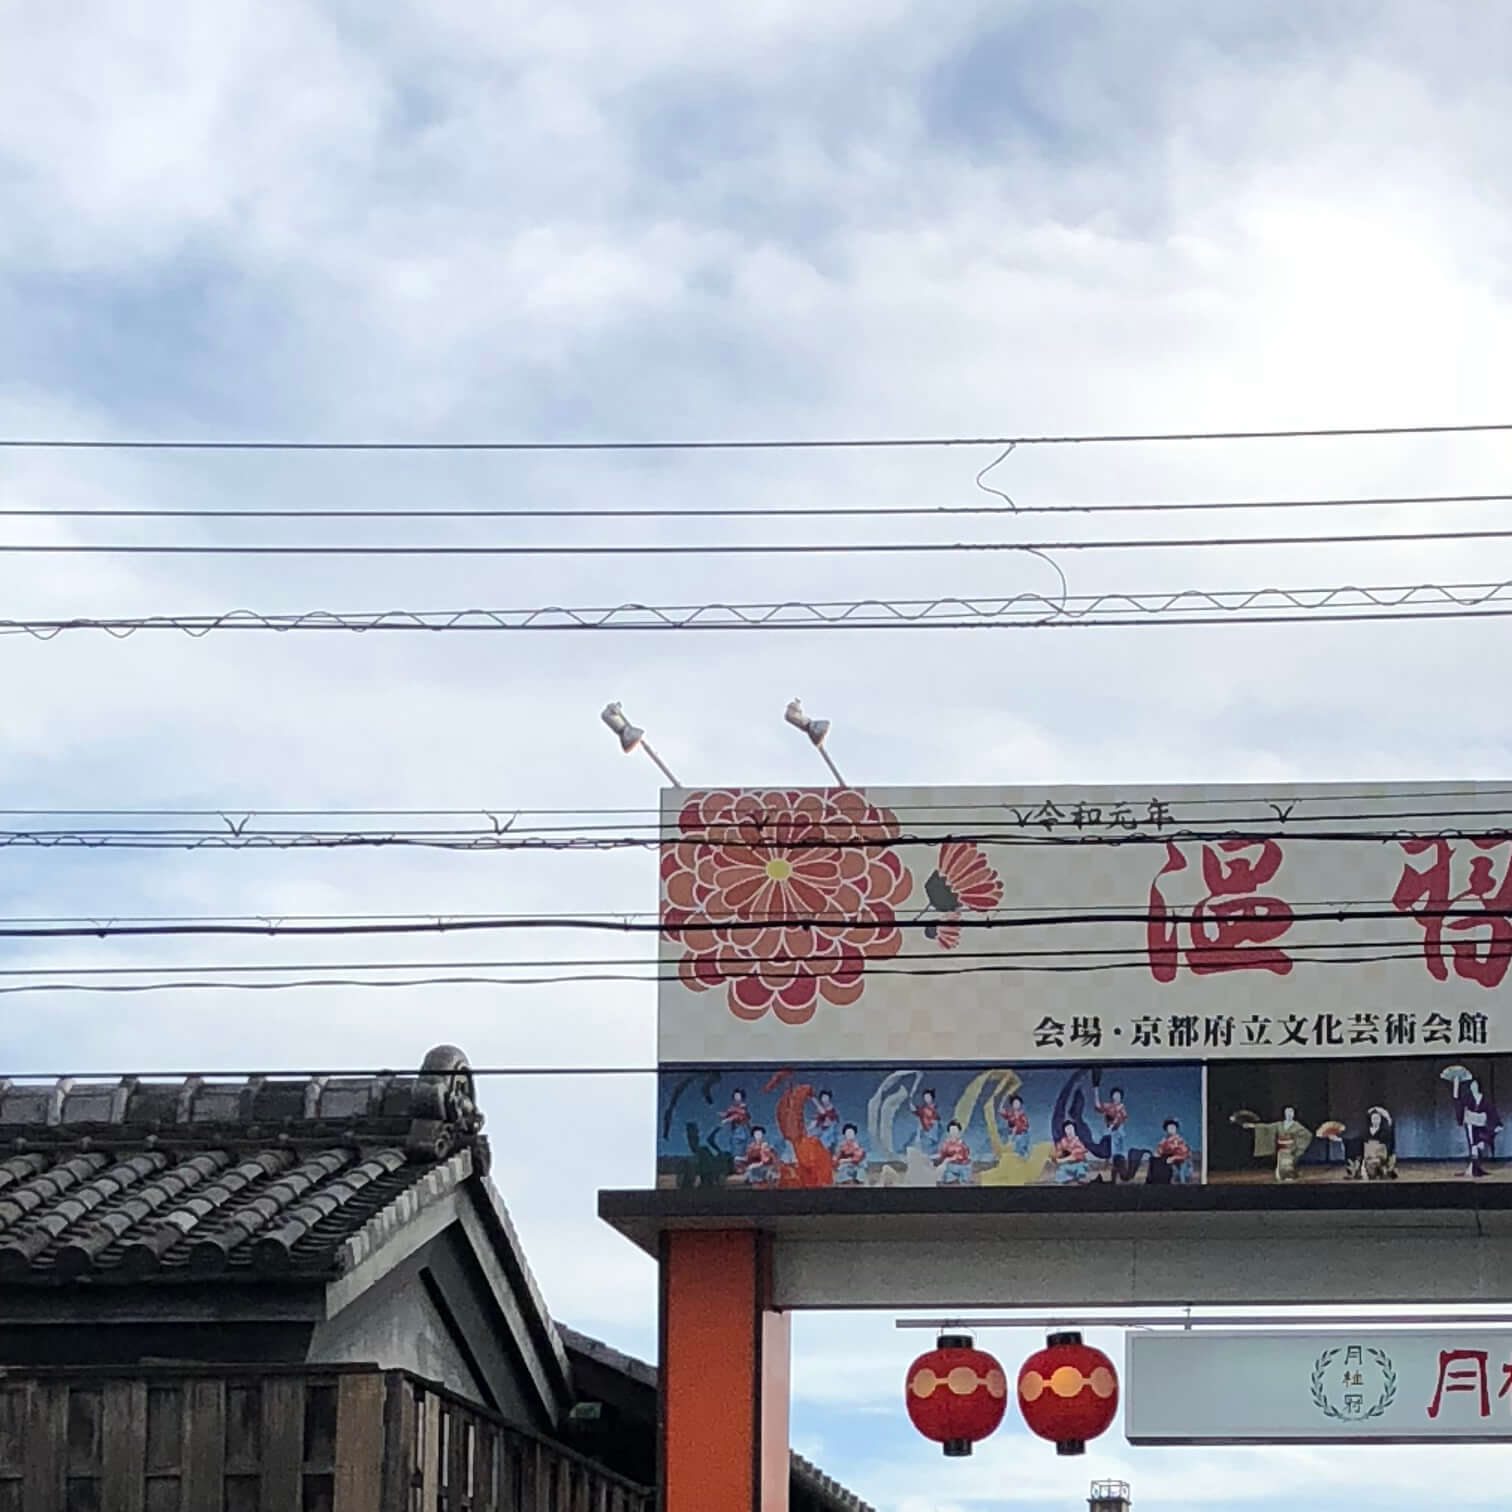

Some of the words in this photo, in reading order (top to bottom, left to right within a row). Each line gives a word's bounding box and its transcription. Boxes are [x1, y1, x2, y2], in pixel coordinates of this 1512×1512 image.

[1033, 1012, 1489, 1048] 会場・京都府立文化芸術会館
